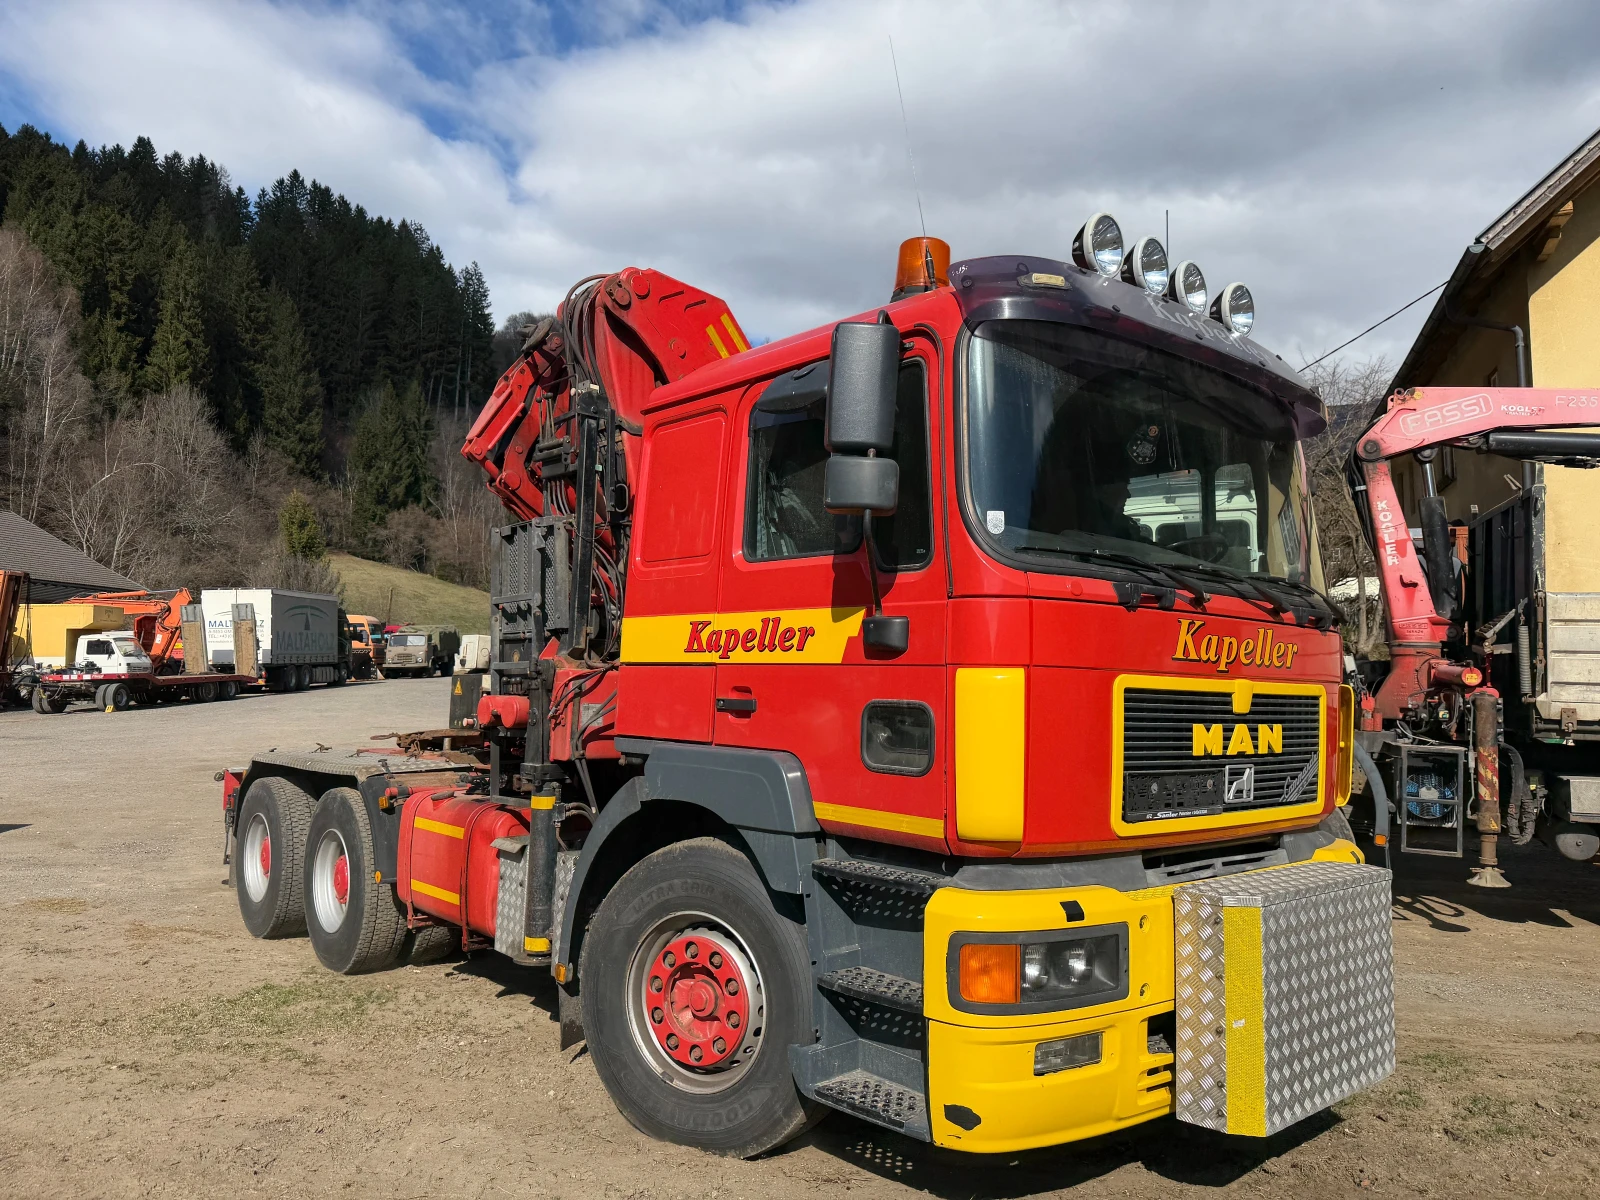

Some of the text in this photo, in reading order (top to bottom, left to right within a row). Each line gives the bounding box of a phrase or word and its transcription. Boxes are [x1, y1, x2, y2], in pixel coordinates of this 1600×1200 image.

[1406, 397, 1487, 431] FASSI
[1376, 499, 1400, 566] KOGLER
[276, 630, 336, 651] MALTAHOLZ
[684, 617, 815, 659] Kapeller
[1171, 618, 1298, 673] Kapeller
[1192, 724, 1283, 756] MAN
